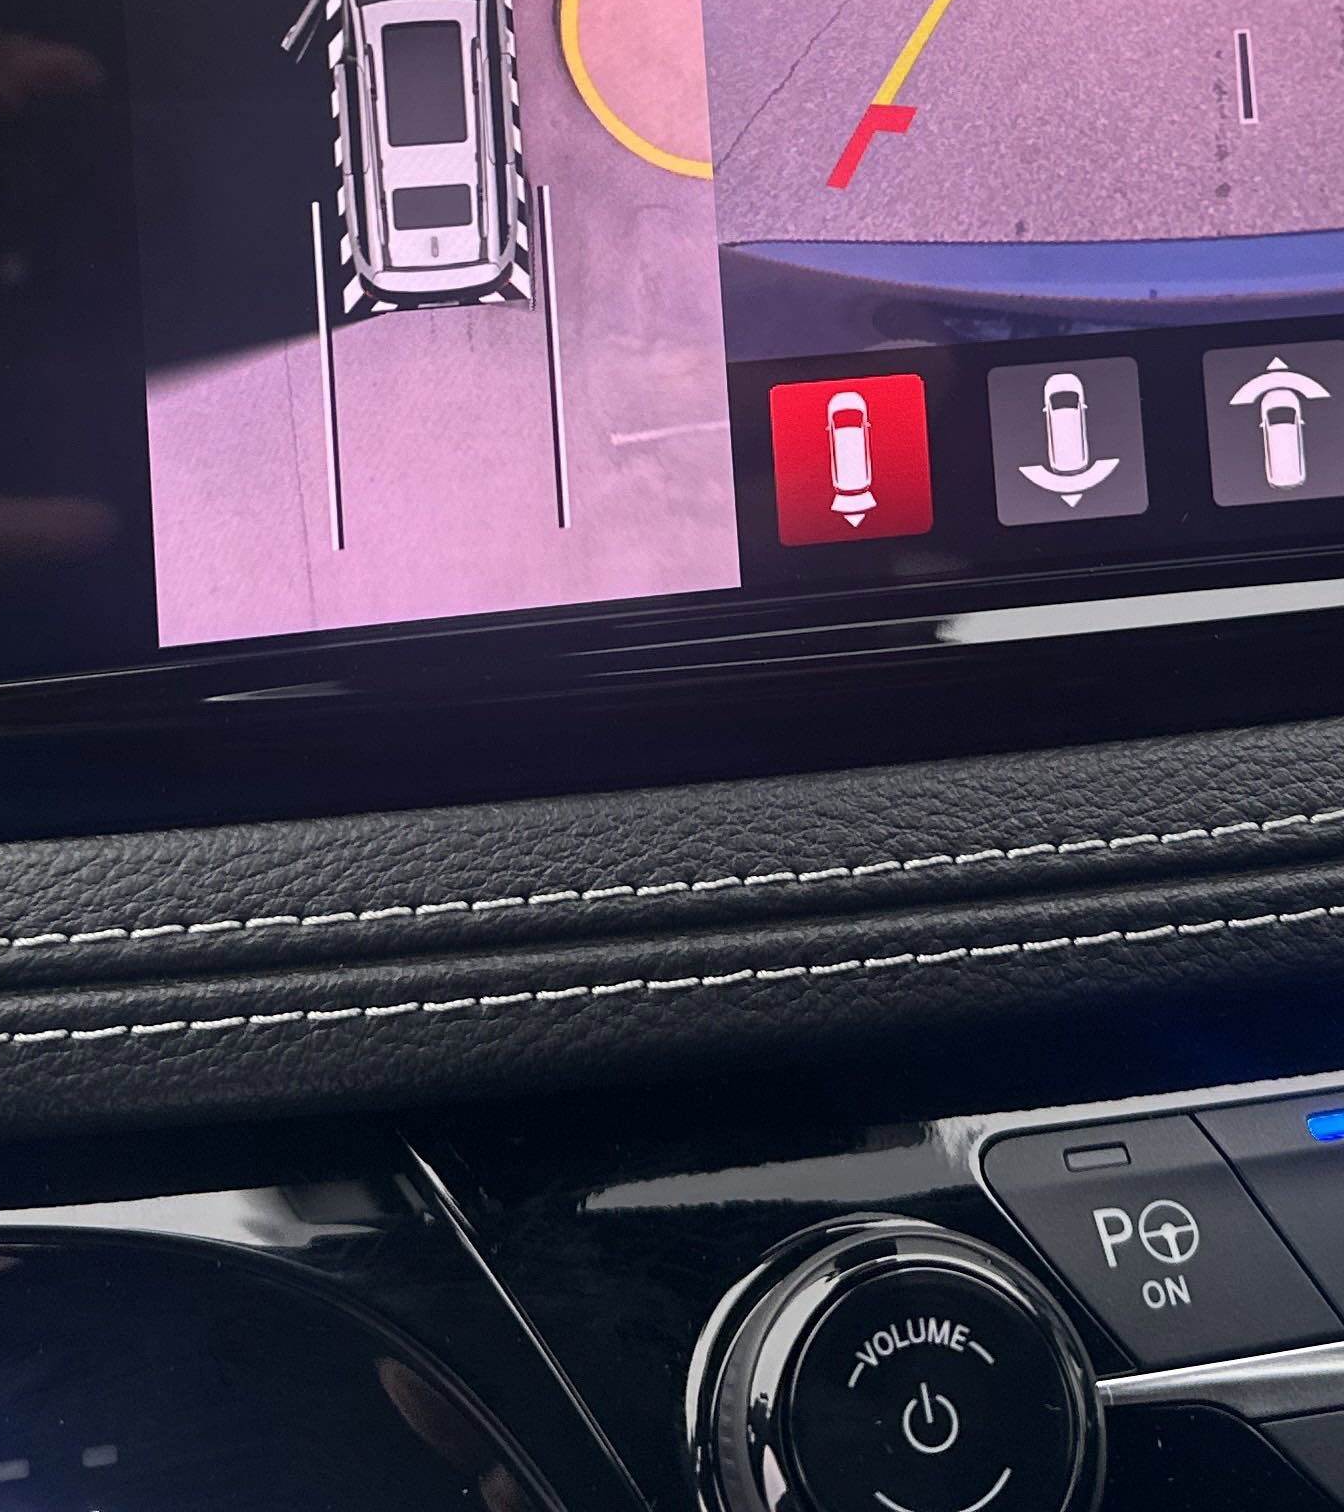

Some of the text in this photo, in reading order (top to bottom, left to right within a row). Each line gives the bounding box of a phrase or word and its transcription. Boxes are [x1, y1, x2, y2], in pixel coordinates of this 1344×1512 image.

[1093, 1207, 1133, 1268] P
[1142, 1274, 1191, 1309] ON
[856, 1317, 971, 1368] VOLUME
